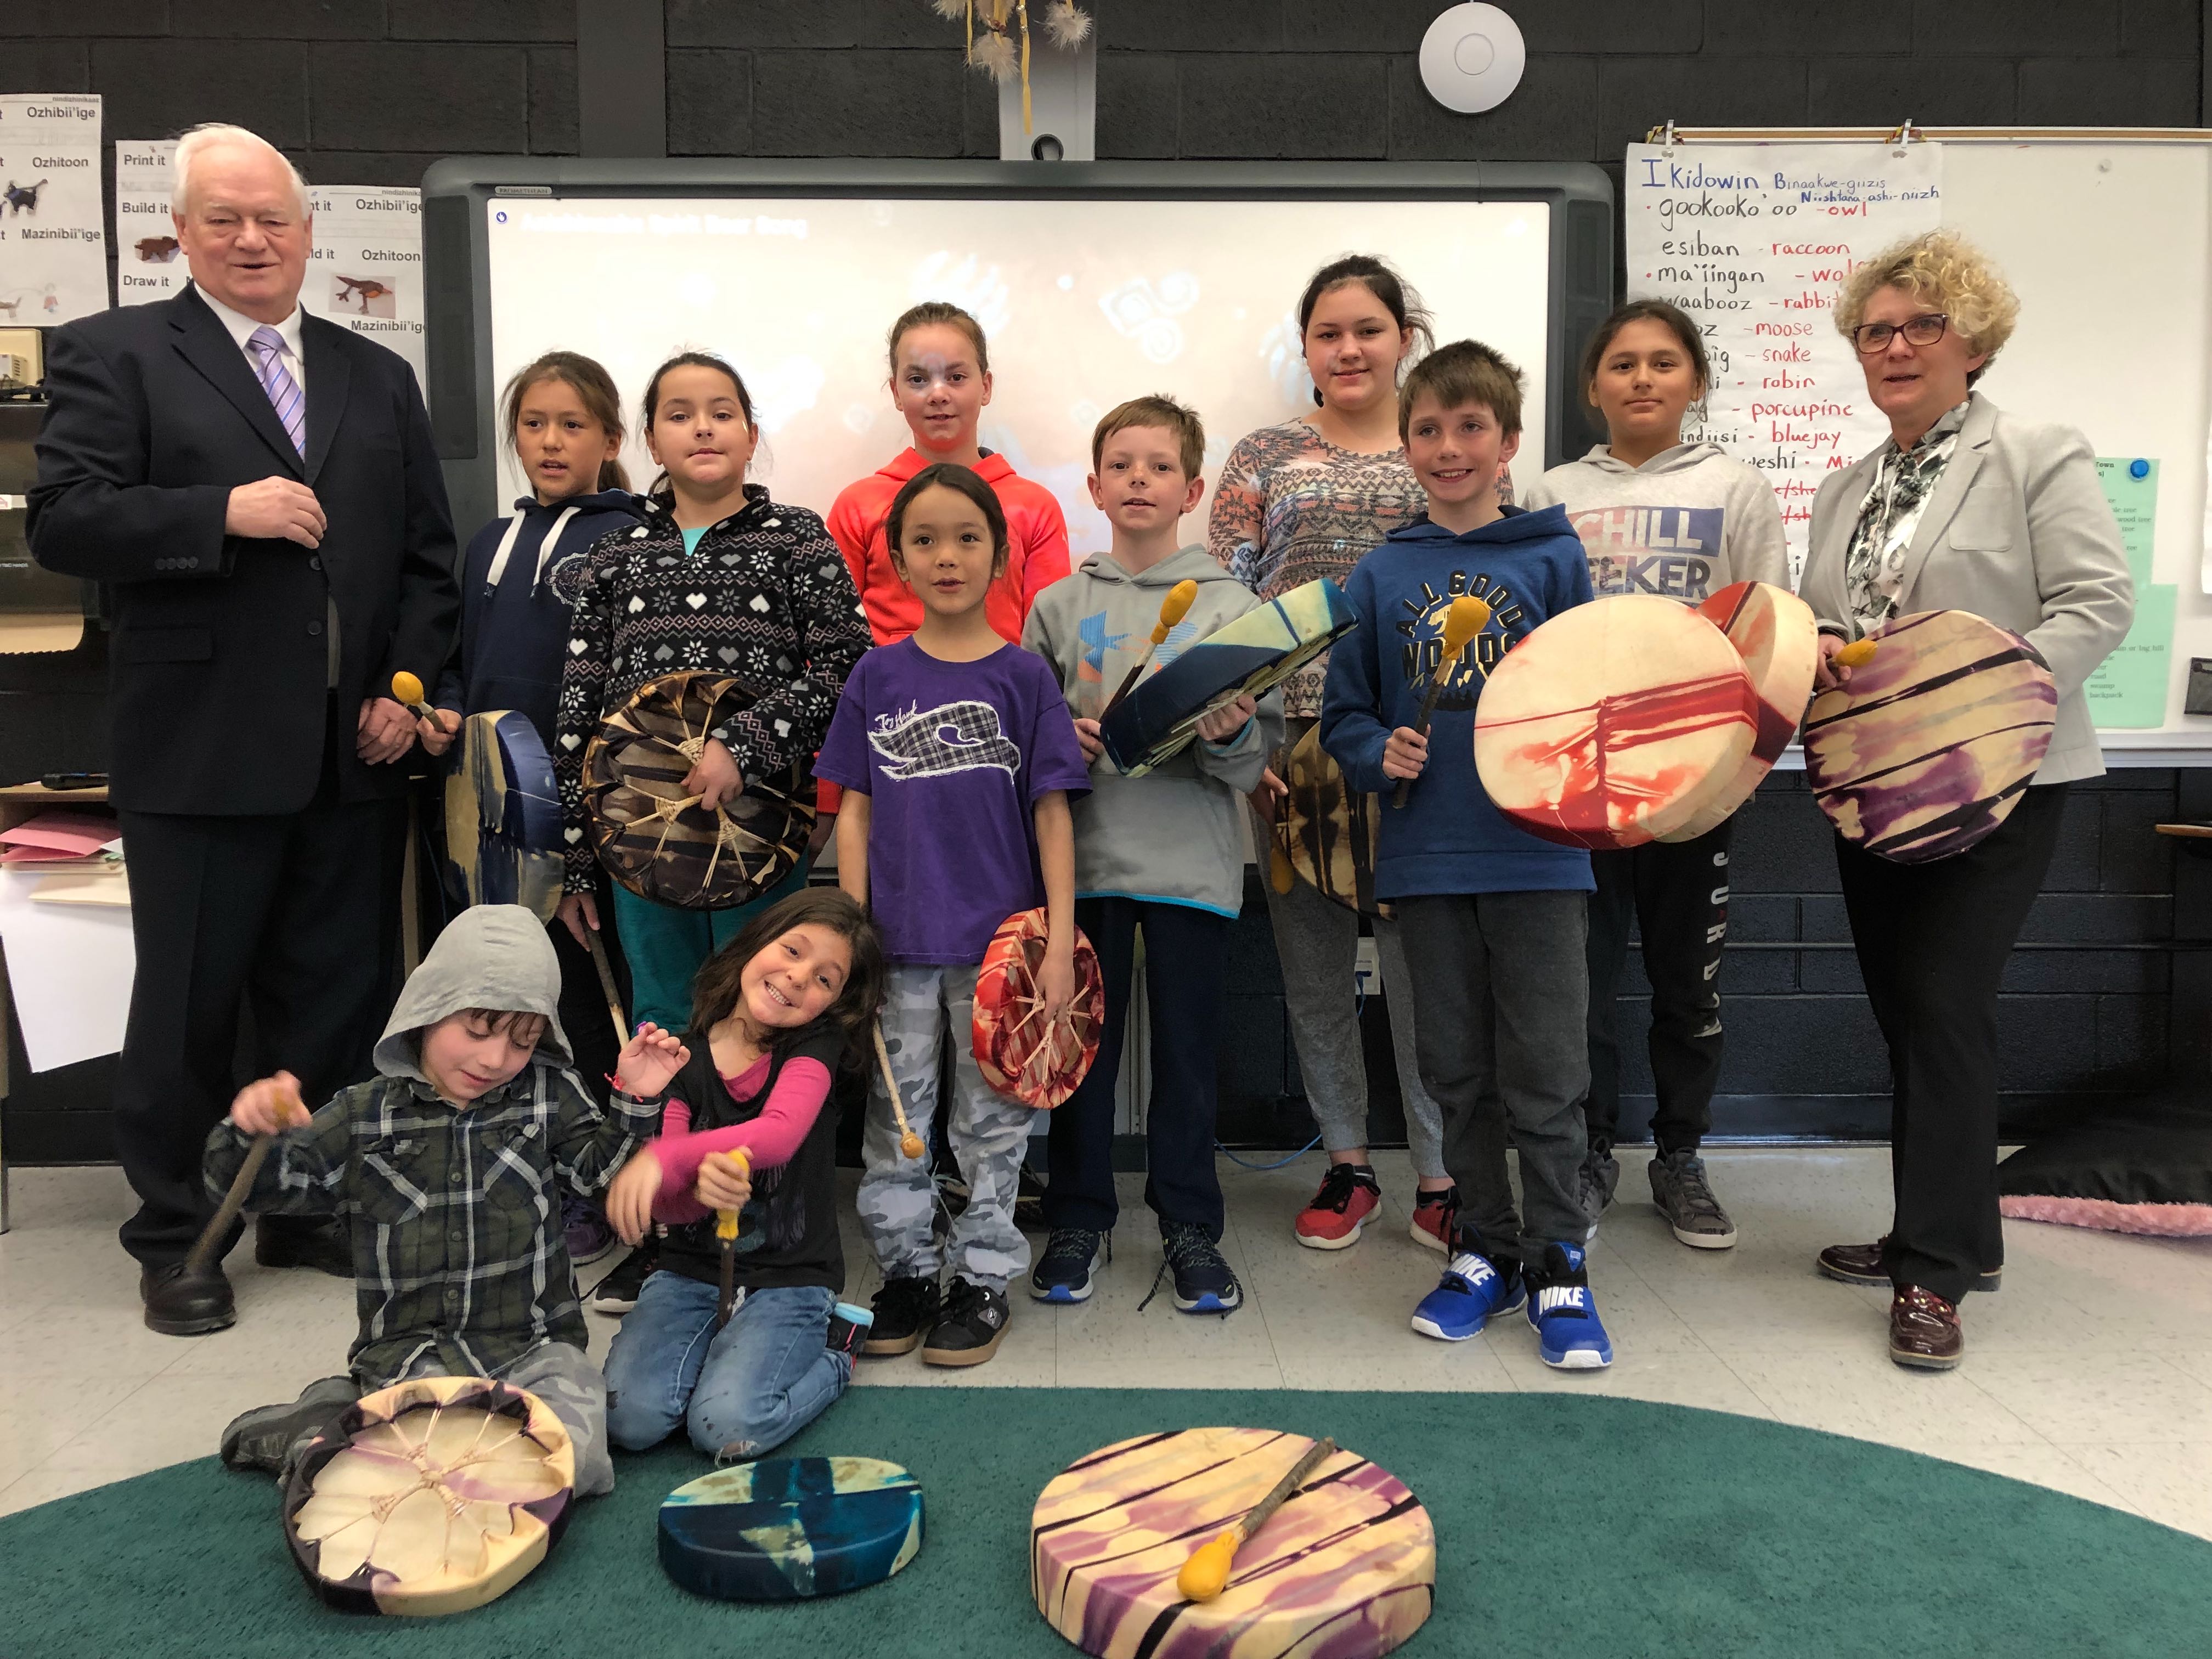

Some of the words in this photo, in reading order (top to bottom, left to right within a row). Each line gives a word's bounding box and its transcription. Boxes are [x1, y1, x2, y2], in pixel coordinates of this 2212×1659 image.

[27, 106, 95, 120] Ozhibii'ige
[32, 156, 89, 167] Ozhitoon
[124, 154, 154, 166] Print
[157, 155, 166, 166] it
[122, 202, 155, 213] Build
[160, 203, 168, 213] it
[323, 202, 331, 211] it
[22, 229, 100, 242] Mazinibii'ige
[1662, 229, 1740, 257] esiban
[1772, 242, 1850, 256] raccoon
[326, 249, 334, 259] it
[362, 249, 420, 262] Ozhitoon
[123, 275, 156, 286] Draw
[161, 275, 169, 286] it
[351, 321, 425, 334] Mazinibii'ig
[1762, 341, 1812, 363] snake
[1763, 369, 1816, 389] robin
[1772, 420, 1841, 449] bluejay
[1448, 569, 1525, 628] GOOD
[1448, 1253, 1496, 1286] NIKE
[1539, 1286, 1584, 1316] NIKE
